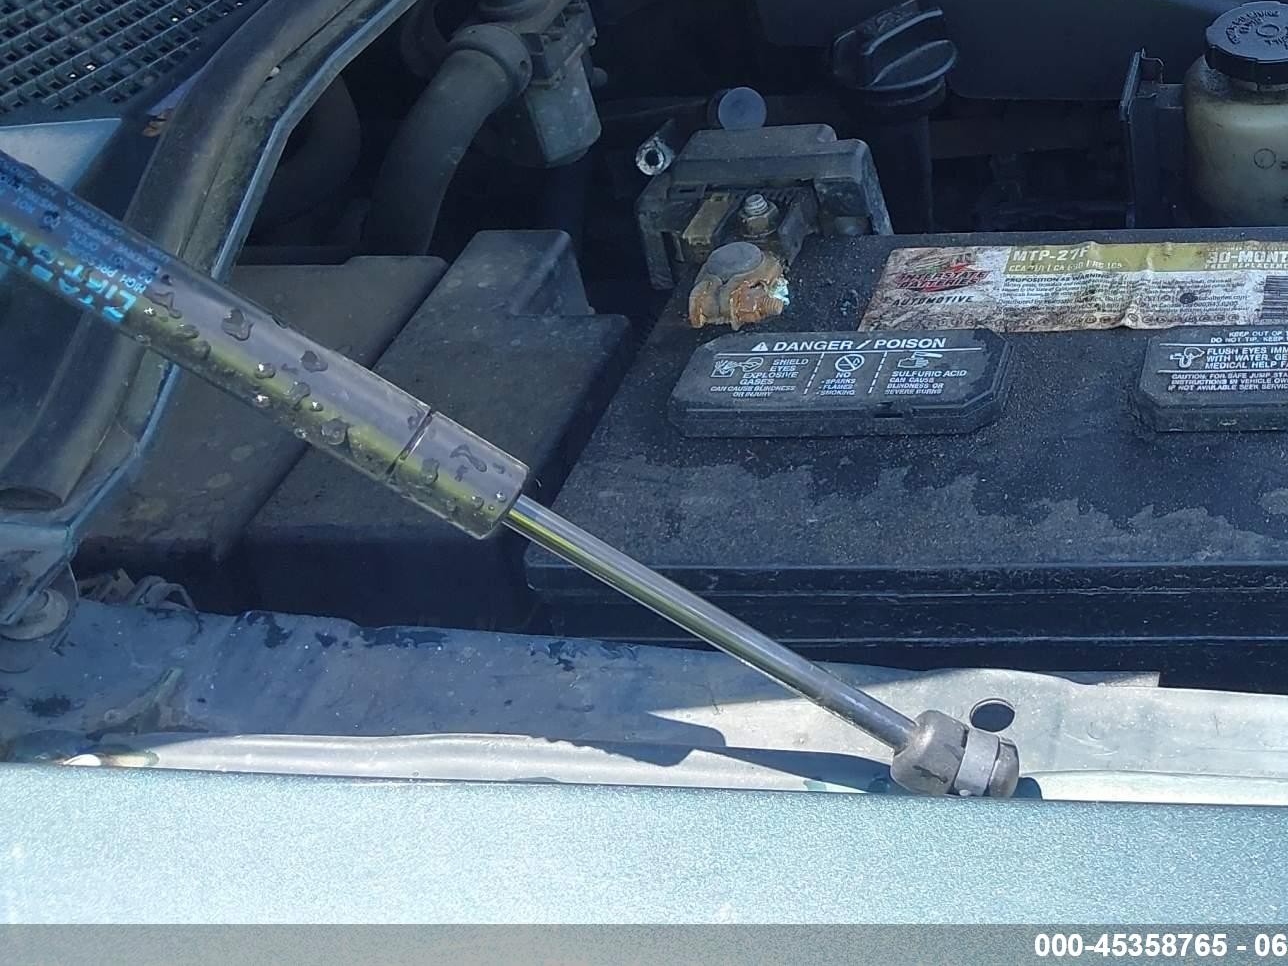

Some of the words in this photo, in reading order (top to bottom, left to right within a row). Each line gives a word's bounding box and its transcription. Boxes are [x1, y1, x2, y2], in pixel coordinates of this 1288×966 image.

[61, 241, 118, 279] PRESSURE
[1013, 246, 1090, 261] MTP-27F
[899, 271, 987, 280] INTERSTATE
[118, 273, 147, 295] HIGH
[899, 278, 980, 288] BATTERIES
[891, 295, 974, 306] AUTOMOTIVE
[773, 340, 853, 351] DANGER
[874, 338, 946, 349] POISON
